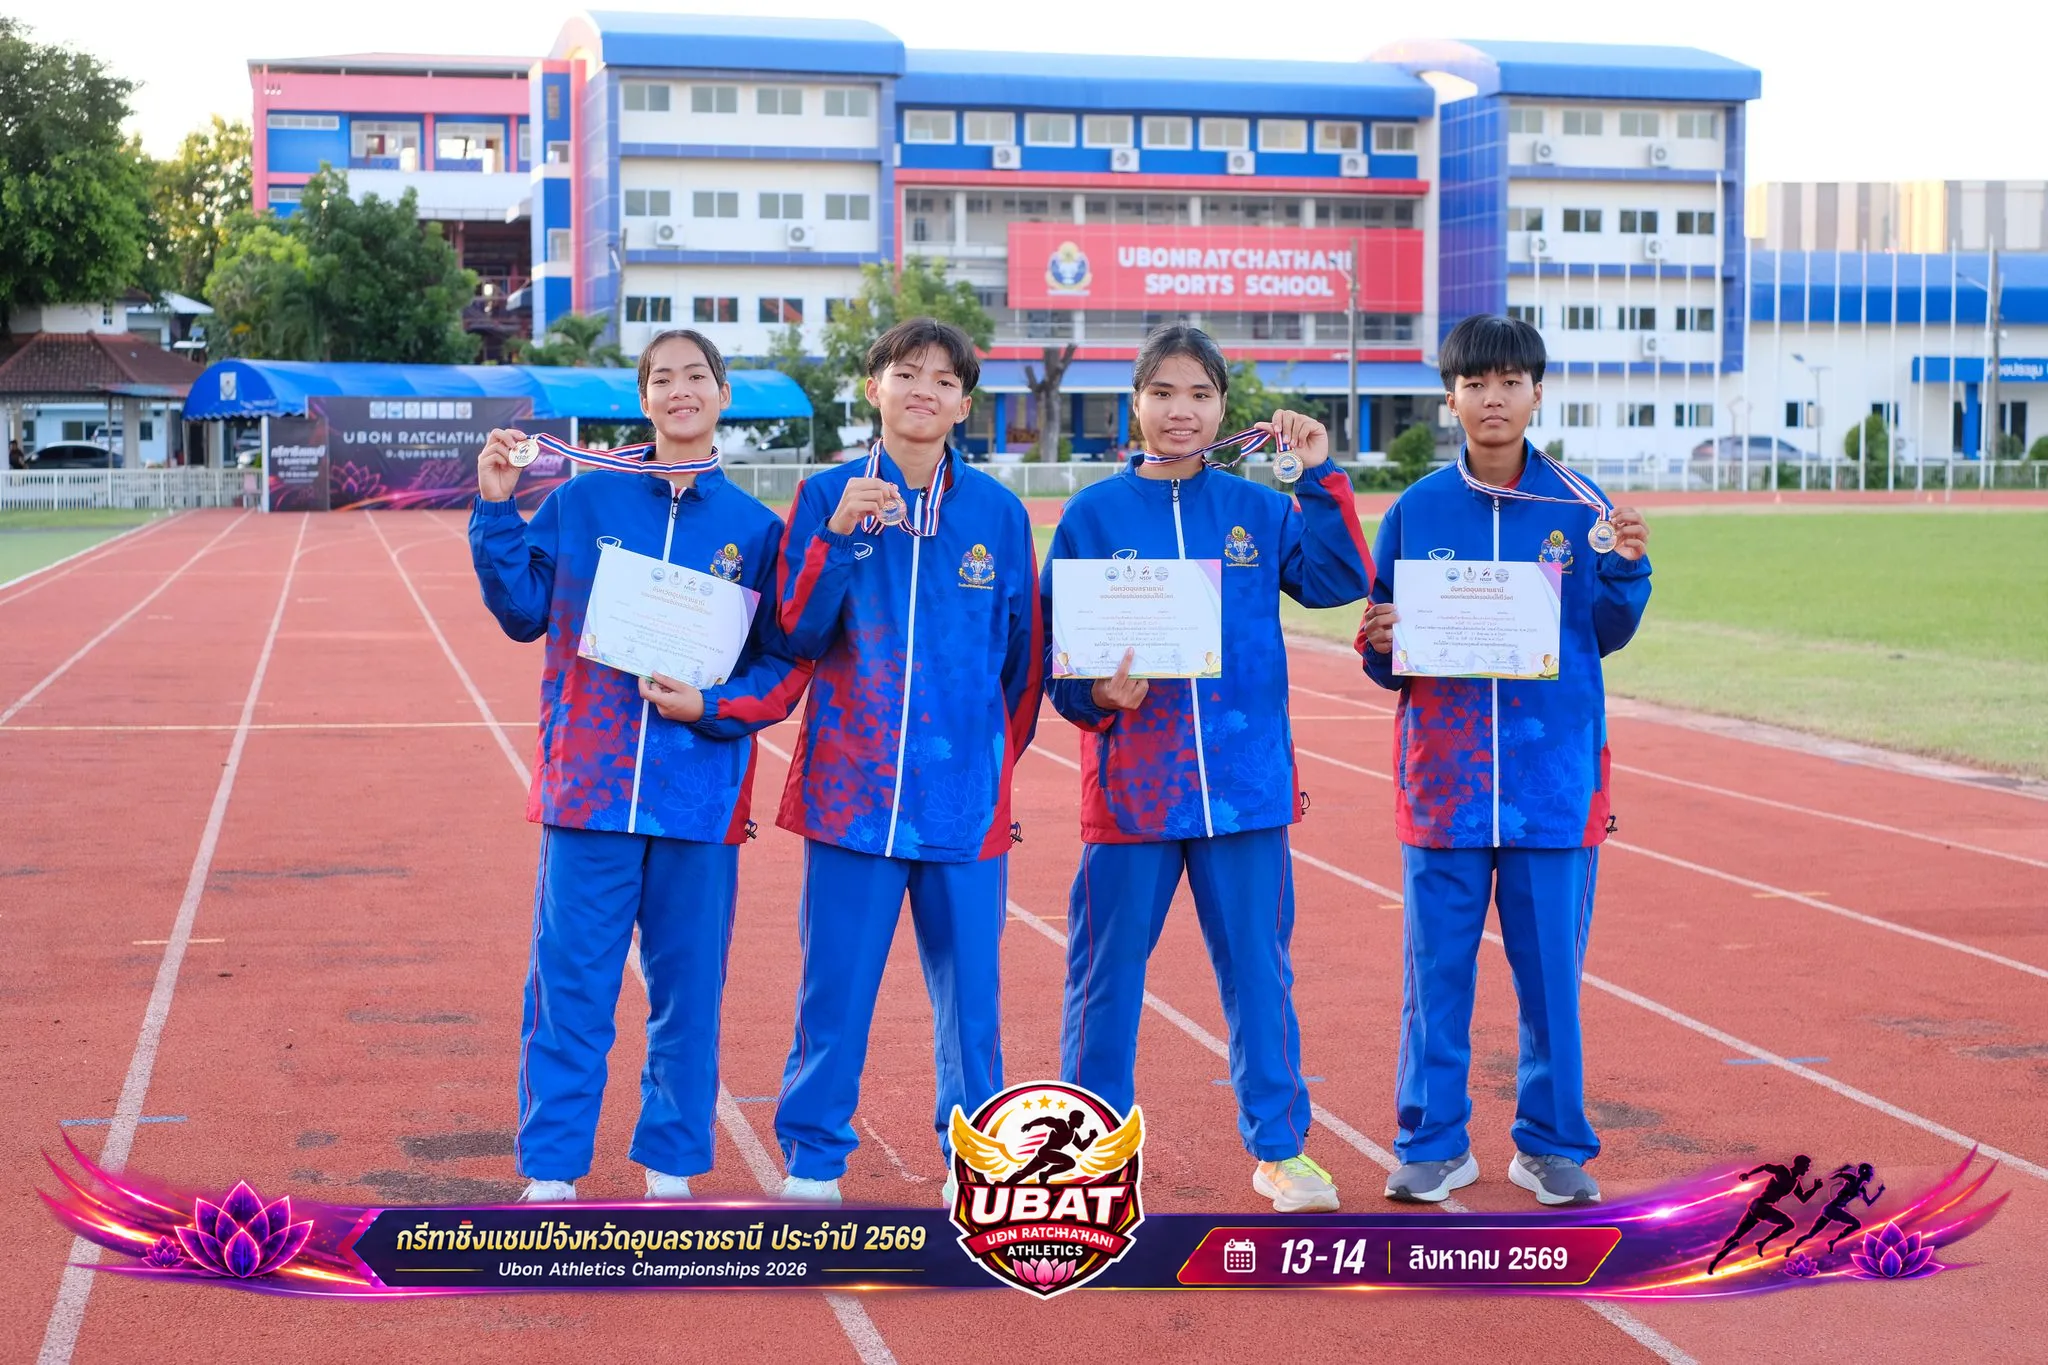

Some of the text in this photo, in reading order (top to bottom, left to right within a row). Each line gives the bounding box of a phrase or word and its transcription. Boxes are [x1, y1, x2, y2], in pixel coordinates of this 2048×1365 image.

[1118, 246, 1352, 271] UBONRATCHATHANI
[1144, 274, 1334, 297] SPORTS SCHOOL
[343, 431, 488, 444] UBON RATCHATHA
